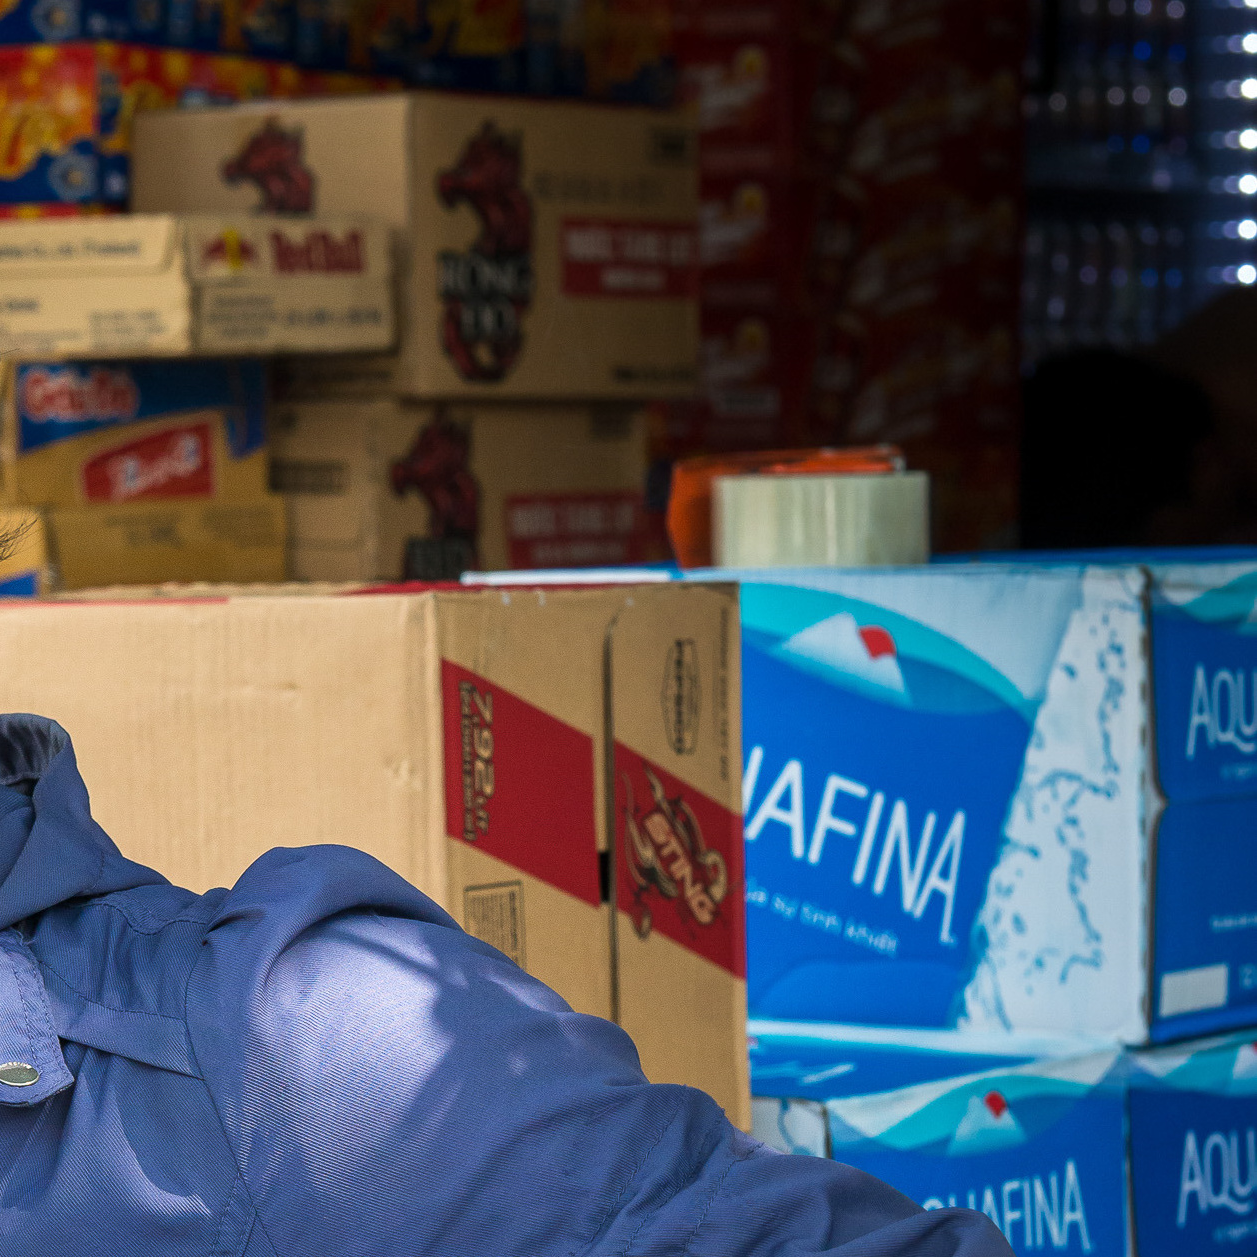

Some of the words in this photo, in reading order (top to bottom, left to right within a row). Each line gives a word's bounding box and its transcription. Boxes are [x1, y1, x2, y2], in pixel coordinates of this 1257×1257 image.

[643, 810, 717, 928] STING
[743, 745, 966, 944] AFINA
[922, 1159, 1095, 1254] AFINA
